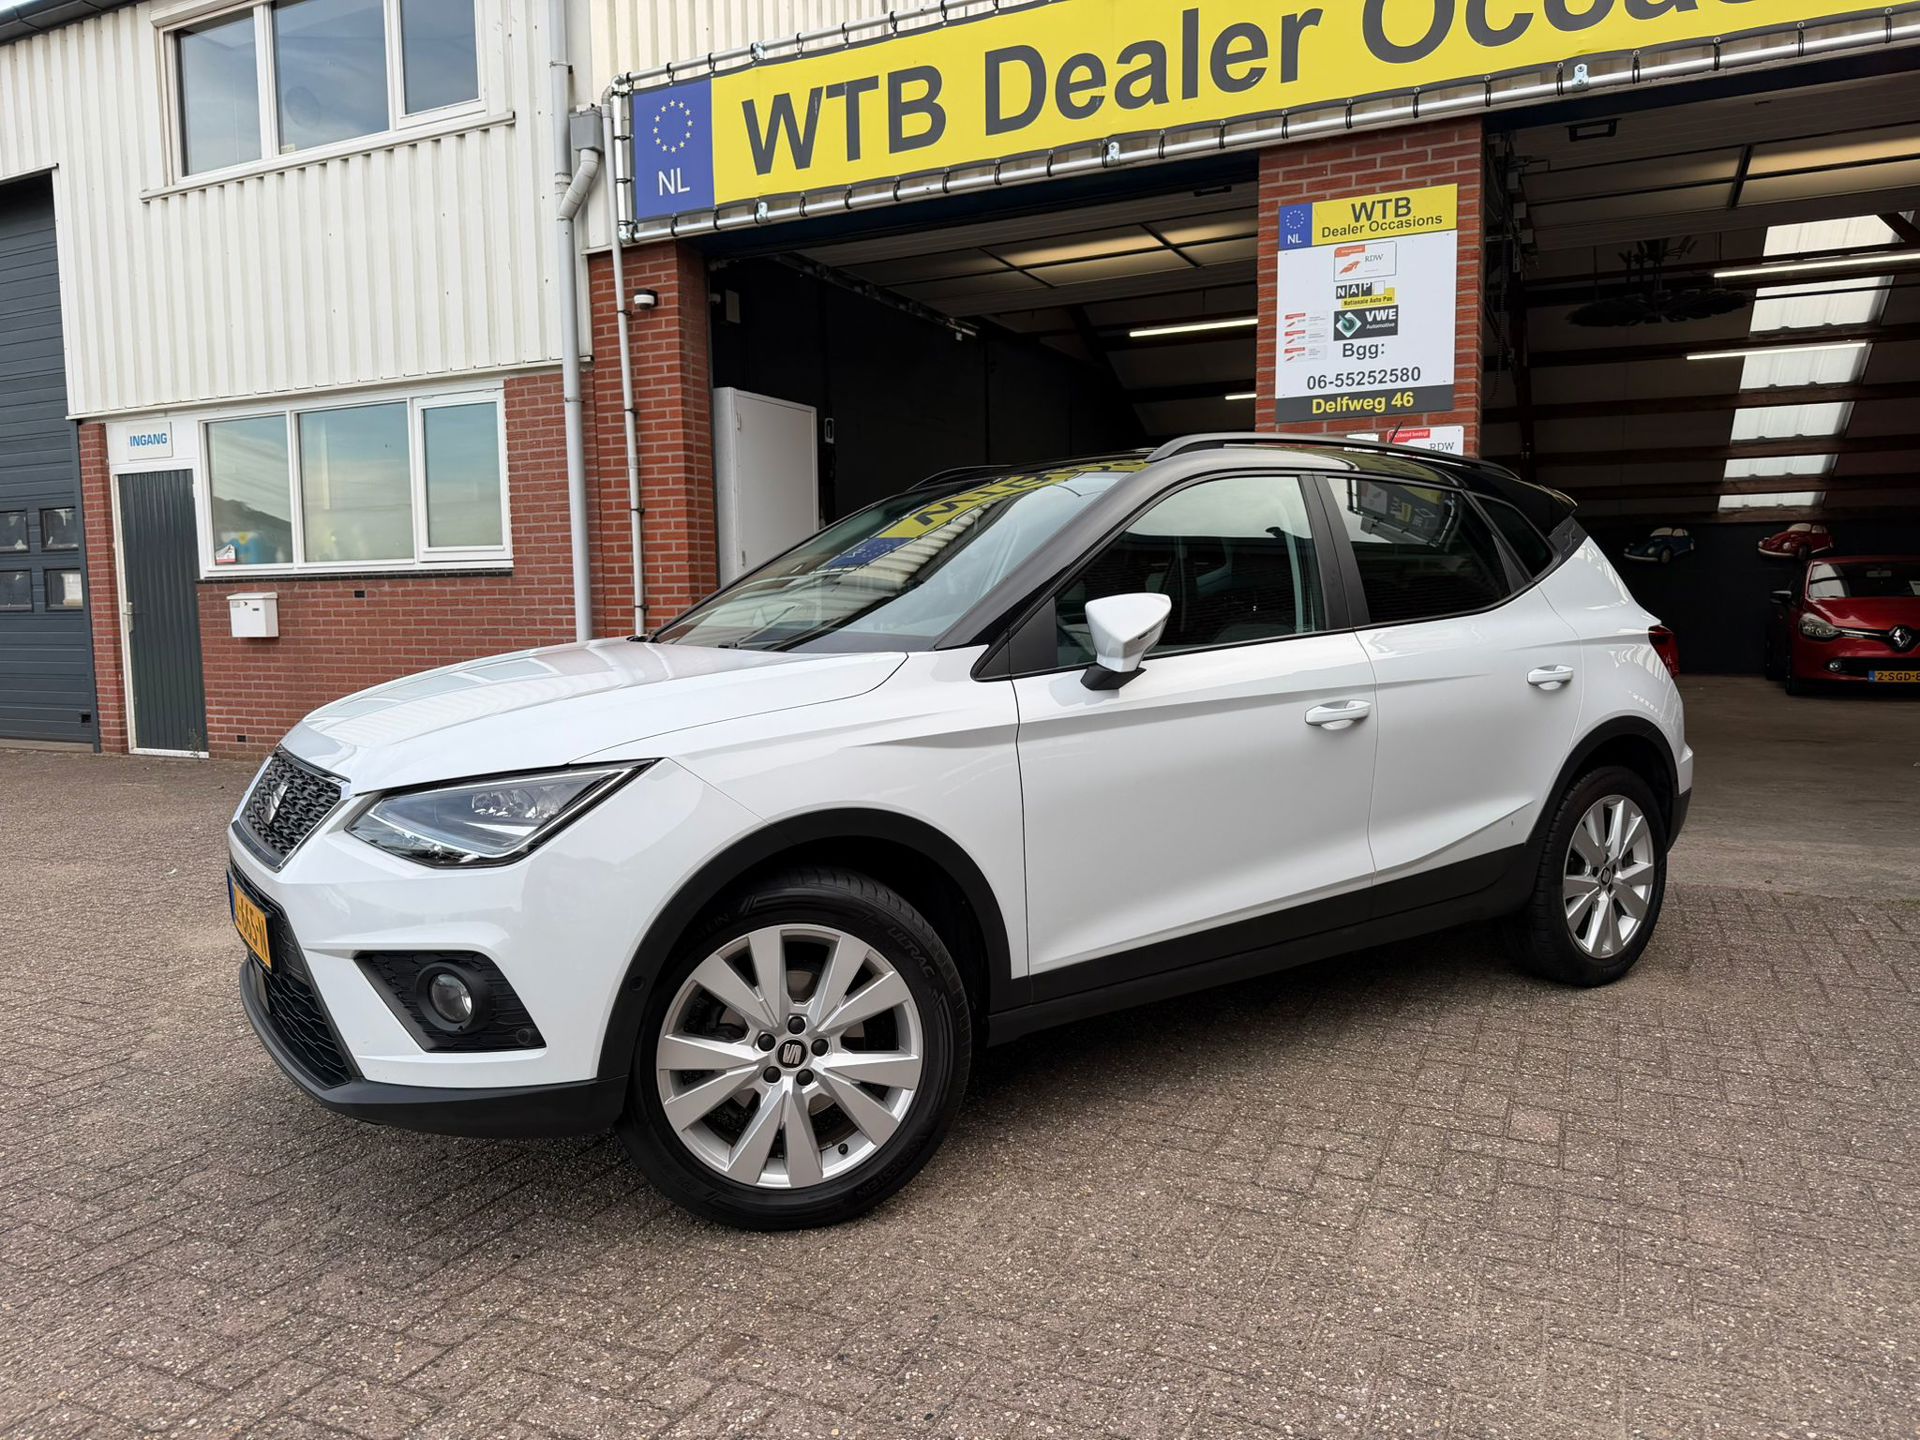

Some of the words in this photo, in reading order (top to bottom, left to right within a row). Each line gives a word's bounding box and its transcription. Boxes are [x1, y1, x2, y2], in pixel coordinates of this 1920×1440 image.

[741, 65, 947, 177] WTB
[984, 7, 1324, 137] Dealer
[658, 168, 690, 196] NL
[1351, 196, 1411, 223] WTB
[1322, 224, 1364, 238] Dealer
[1369, 214, 1442, 233] Occasions
[1287, 233, 1302, 244] NL
[1365, 254, 1383, 262] RDW
[1365, 309, 1397, 322] VWE
[1342, 342, 1385, 360] Bgg:
[1307, 366, 1421, 390] 06-55252580
[1312, 396, 1386, 414] Delfweg
[1391, 391, 1414, 408] 46
[129, 432, 168, 447] INGANG
[1429, 441, 1454, 451] RDW
